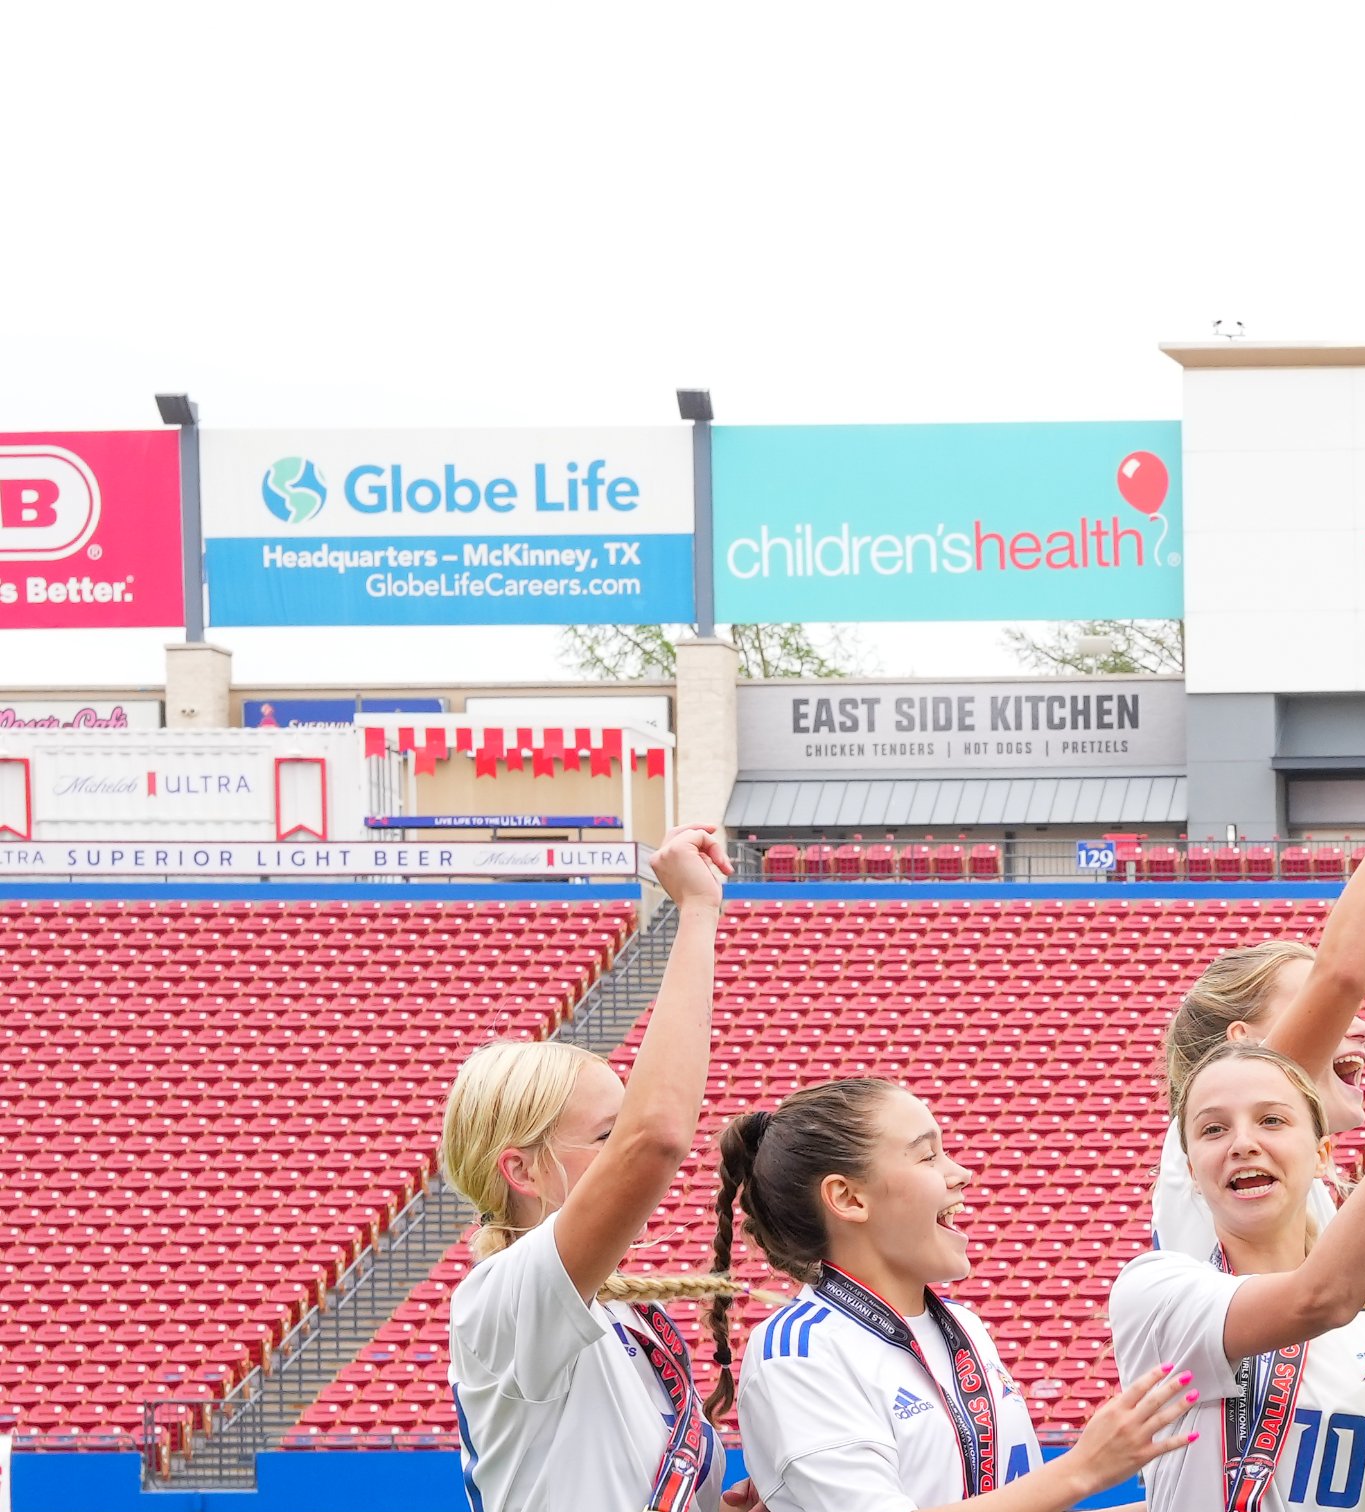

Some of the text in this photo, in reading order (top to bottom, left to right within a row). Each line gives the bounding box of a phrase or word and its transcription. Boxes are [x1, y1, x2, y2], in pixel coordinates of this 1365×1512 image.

[344, 459, 640, 514] Globe Life
[262, 542, 641, 574] Headquarters McKinney, TX
[26, 576, 134, 603] Better.
[365, 571, 641, 598] GlobeLifeCareers.com
[792, 693, 1141, 736] EAST SIDE KITCHEN
[804, 739, 1130, 758] CHICKEN TENDERS HOT DOGS PRETZELS
[164, 775, 252, 794] ULTRA
[501, 816, 541, 826] ULTRA
[68, 850, 234, 867] SUPERIOR
[257, 850, 352, 867] LIGHT
[373, 850, 454, 866] BEER
[560, 851, 629, 866] ULTRA
[1078, 849, 1114, 868] 129
[652, 1311, 685, 1357] CUP
[954, 1348, 982, 1393] CUP
[1255, 1364, 1297, 1451] DALLAS
[968, 1396, 994, 1494] DALLAS
